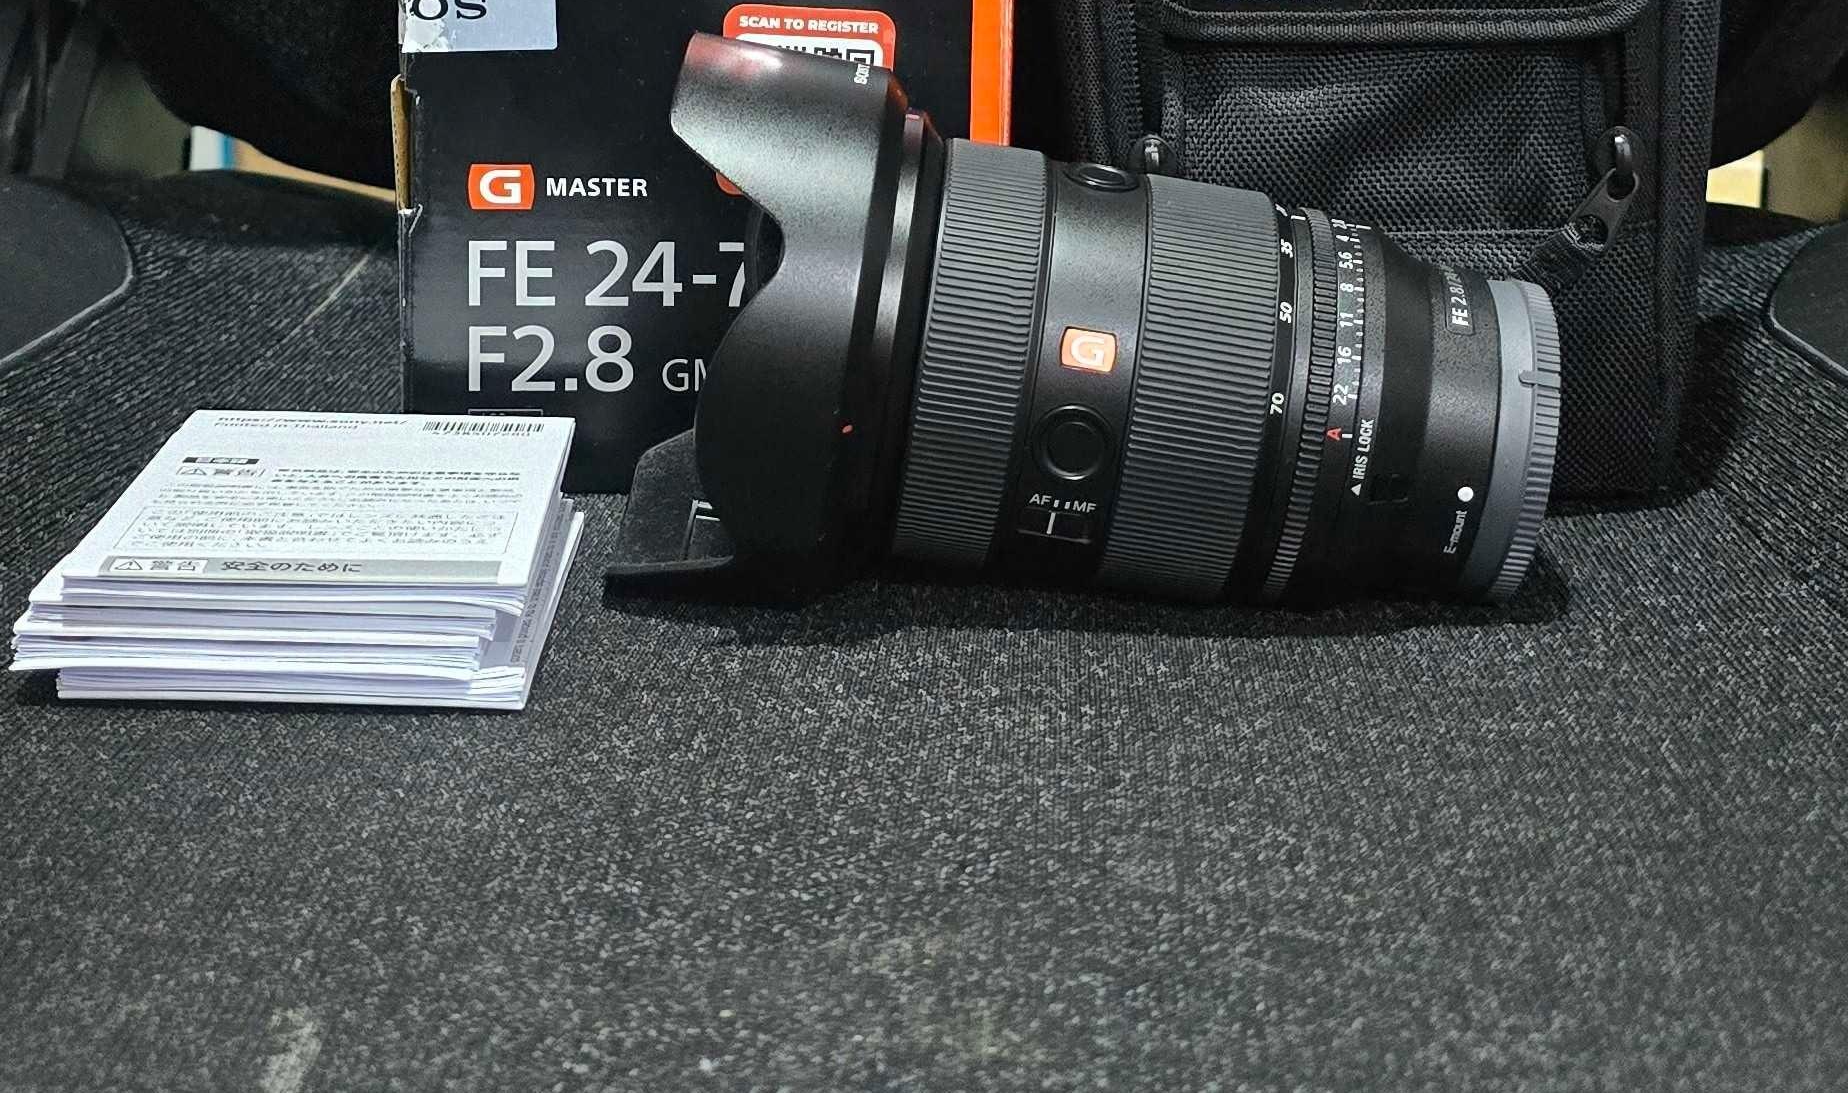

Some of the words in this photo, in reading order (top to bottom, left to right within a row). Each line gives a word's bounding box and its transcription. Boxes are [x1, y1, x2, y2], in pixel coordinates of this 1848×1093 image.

[739, 15, 781, 30] SCAN
[784, 18, 805, 31] TO
[807, 19, 879, 35] REGISTER
[479, 169, 522, 204] G
[546, 177, 648, 197] MASTER
[1280, 238, 1294, 258] 35
[1339, 251, 1353, 269] 5.6
[468, 240, 556, 306] FE
[584, 240, 745, 307] 24-7
[1340, 282, 1354, 293] 8
[1279, 301, 1293, 324] 50
[1340, 311, 1354, 328] 11
[1451, 307, 1469, 326] FE
[468, 325, 634, 393] F2.8
[1070, 334, 1105, 367] G
[1337, 345, 1352, 365] 16
[1270, 392, 1285, 415] 70
[1332, 383, 1349, 406] 22
[1326, 426, 1342, 441] A
[1357, 418, 1374, 448] LOCK
[1352, 450, 1366, 480] IRIS
[1029, 493, 1051, 506] AF
[1072, 500, 1096, 513] MF
[1444, 509, 1467, 556] E-mount
[220, 561, 363, 573] 安全のために
